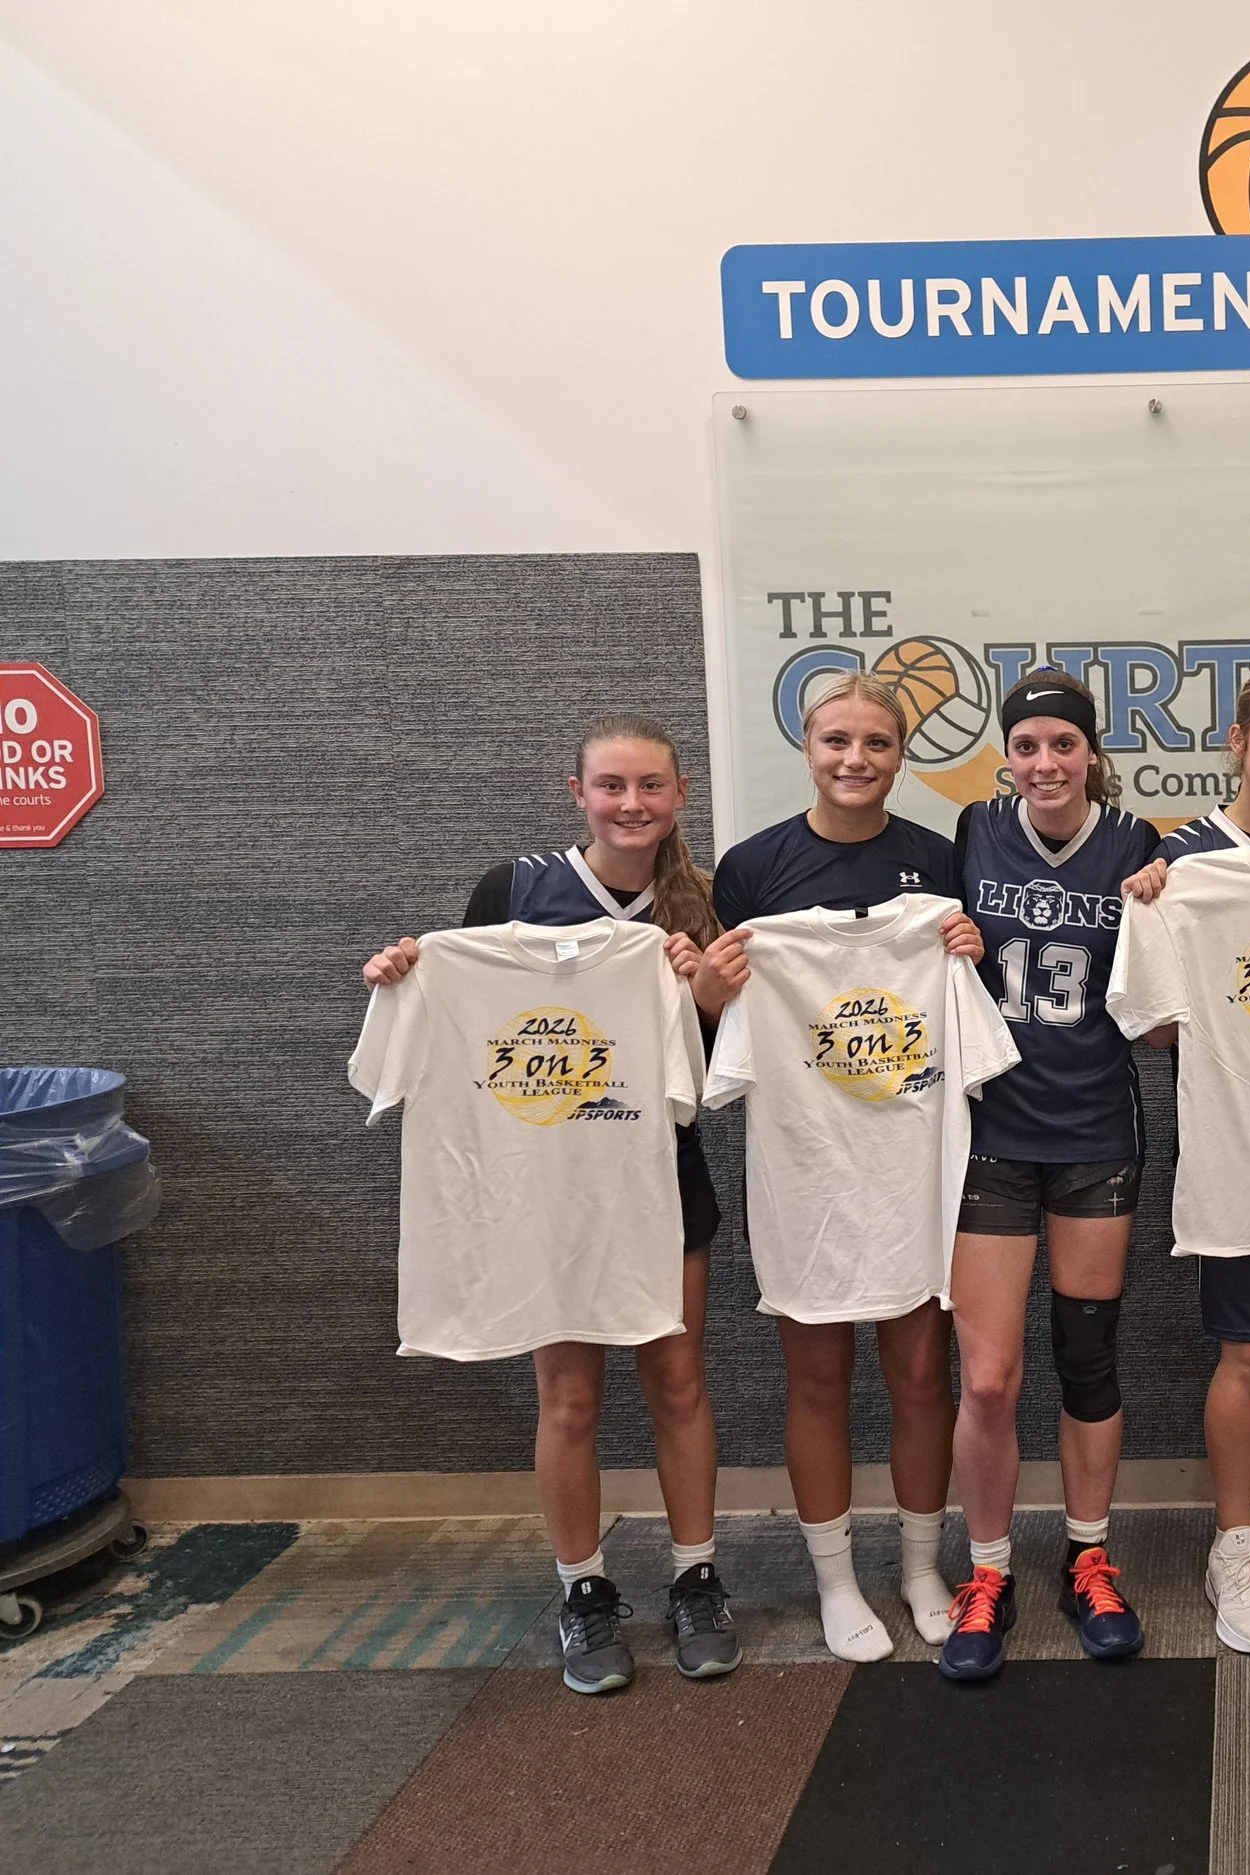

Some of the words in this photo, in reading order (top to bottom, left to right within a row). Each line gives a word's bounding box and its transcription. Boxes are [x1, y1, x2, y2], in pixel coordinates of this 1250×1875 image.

[767, 591, 893, 639] THE
[0, 698, 37, 734] O
[31, 739, 73, 764] OR
[0, 765, 67, 790] NKS
[13, 794, 51, 806] courts
[12, 824, 31, 832] thank
[976, 879, 1124, 931] LIONS
[998, 937, 1092, 1027] 13
[835, 997, 888, 1019] 2026
[518, 1018, 577, 1036] 2026
[808, 1021, 858, 1031] MARCH
[863, 1012, 927, 1026] MADNESS
[547, 1039, 617, 1047] MADNESS
[816, 1031, 835, 1060] 3
[847, 1034, 893, 1058] on
[902, 1021, 922, 1053] 3
[489, 1047, 515, 1080] 3
[526, 1055, 574, 1078] on
[582, 1048, 609, 1079] 3
[803, 1060, 852, 1069] YOUTH
[848, 1063, 905, 1076] LEAGUE
[473, 1080, 529, 1089] YOUTH
[536, 1079, 628, 1089] BASKETBALL
[522, 1088, 582, 1096] LEAGUE
[847, 1624, 874, 1643] DRI-FIT
